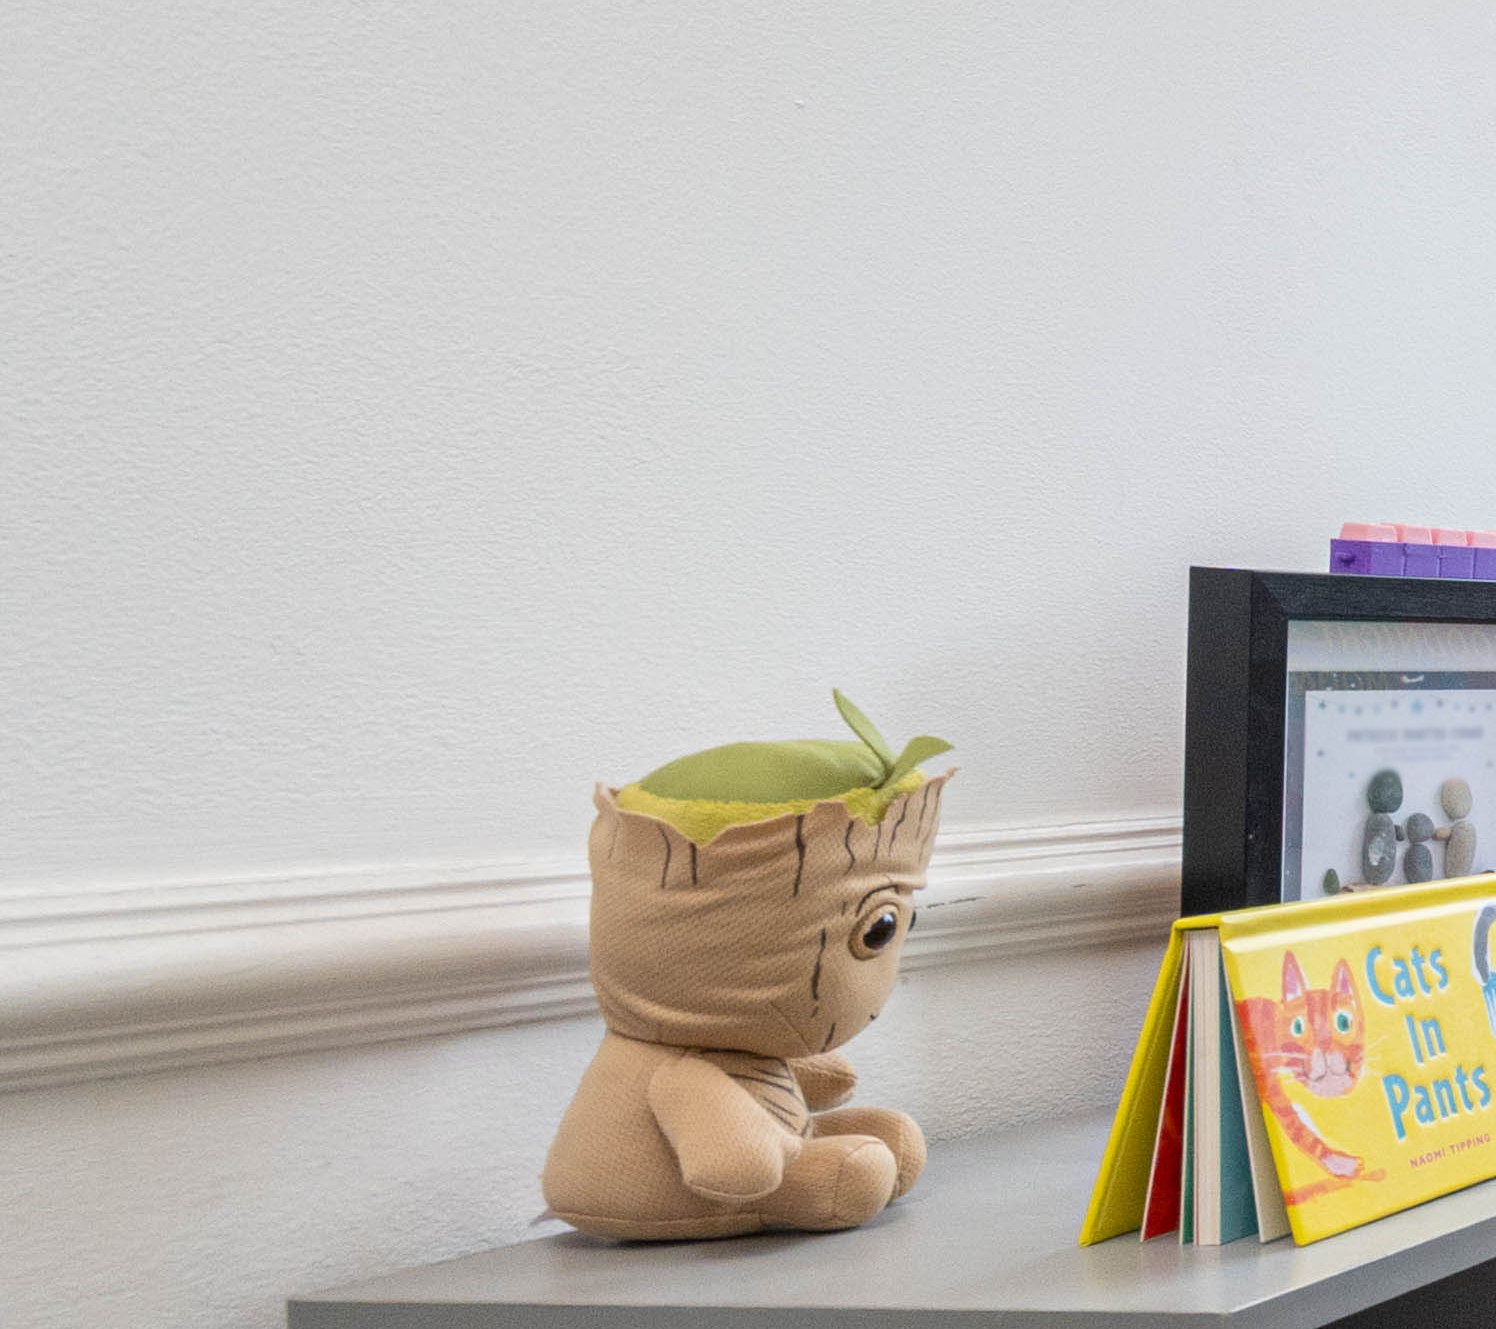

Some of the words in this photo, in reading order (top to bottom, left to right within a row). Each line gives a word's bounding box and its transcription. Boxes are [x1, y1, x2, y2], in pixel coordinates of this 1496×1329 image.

[1365, 947, 1449, 1007] Cats
[1405, 1014, 1447, 1066] In
[1382, 1063, 1491, 1141] Pants
[1409, 1147, 1446, 1168] NAOMI
[1448, 1133, 1491, 1155] TIPPING
